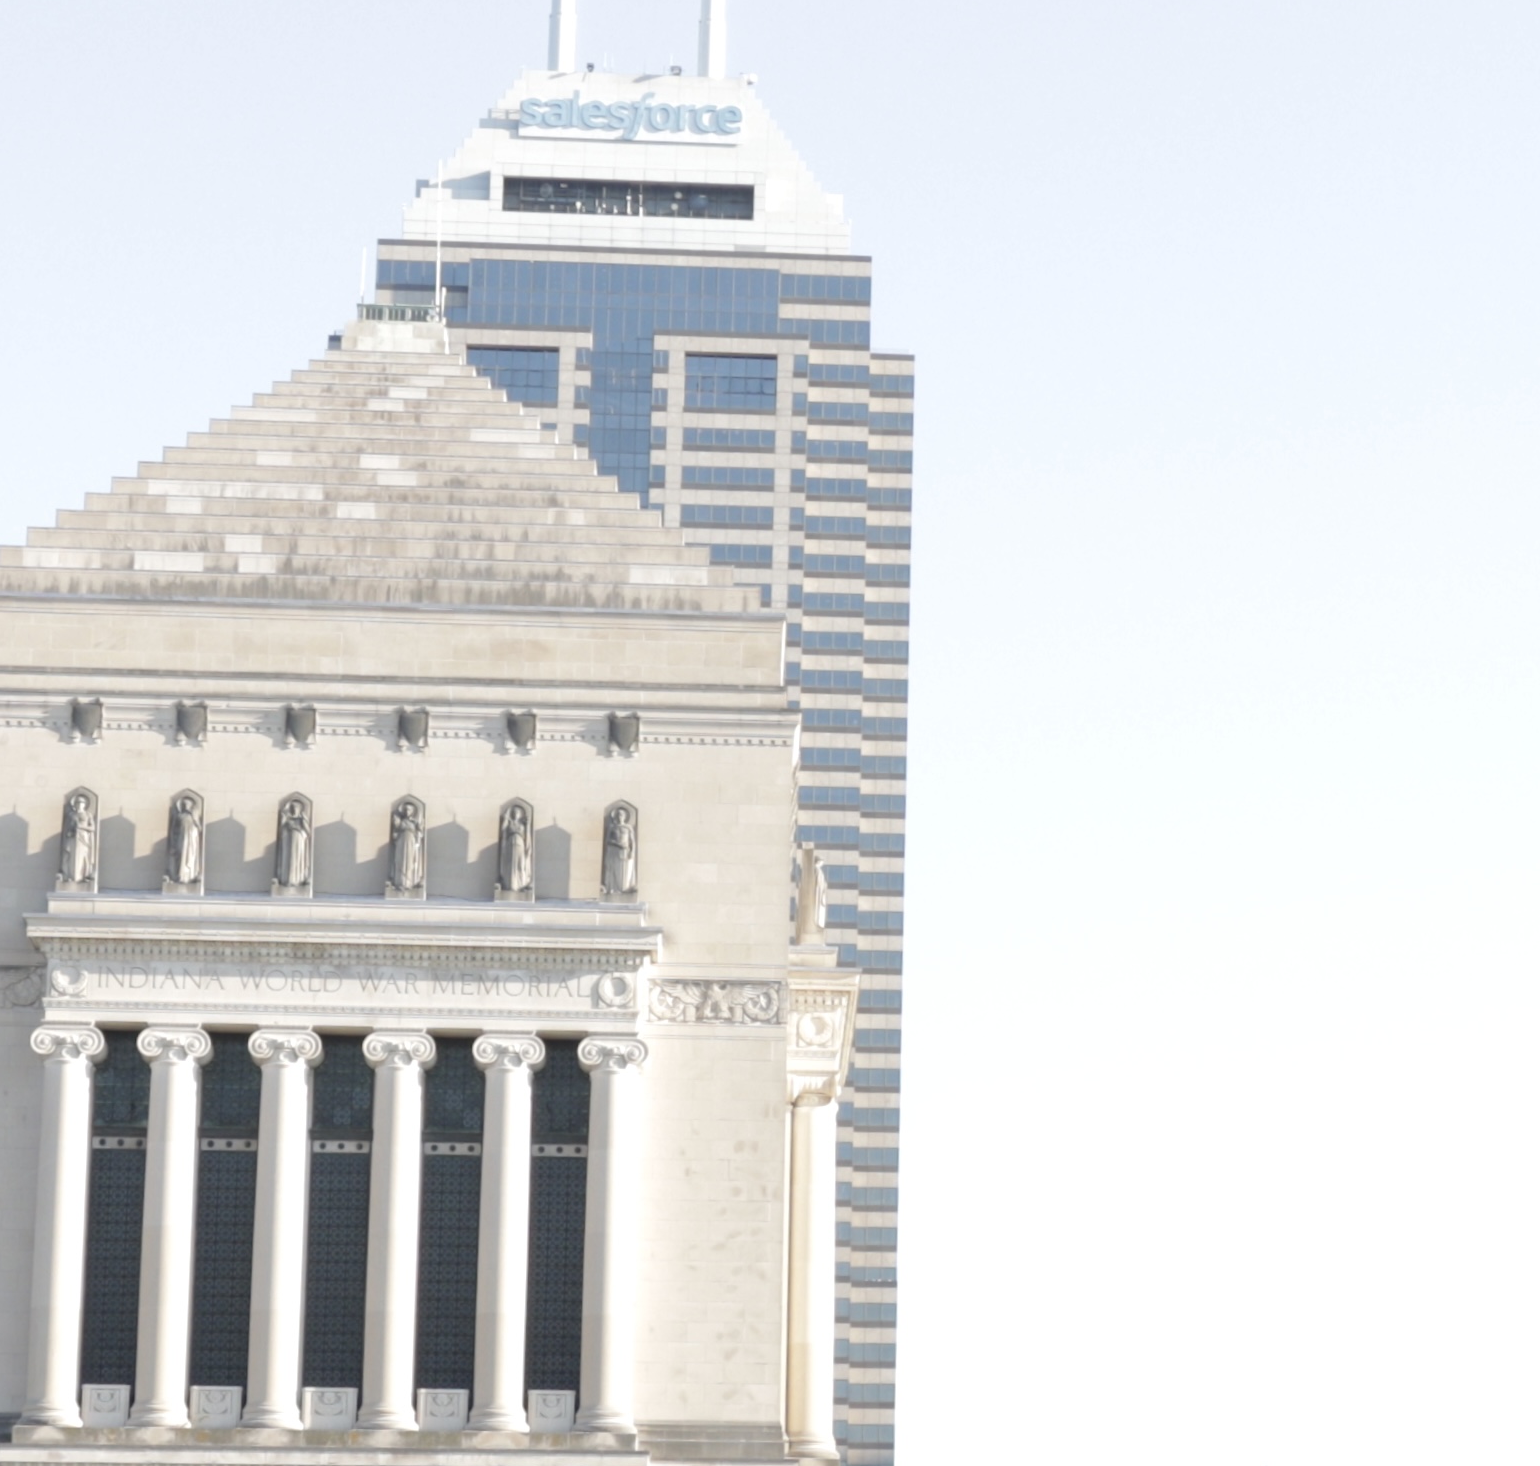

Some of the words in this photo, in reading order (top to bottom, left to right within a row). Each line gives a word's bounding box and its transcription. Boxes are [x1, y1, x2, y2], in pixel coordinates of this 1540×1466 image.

[520, 89, 743, 141] salesforce
[96, 966, 226, 990] INDIANA
[236, 968, 343, 993] WORLD
[355, 970, 420, 995] WAR
[431, 972, 592, 998] MEMORIAL
